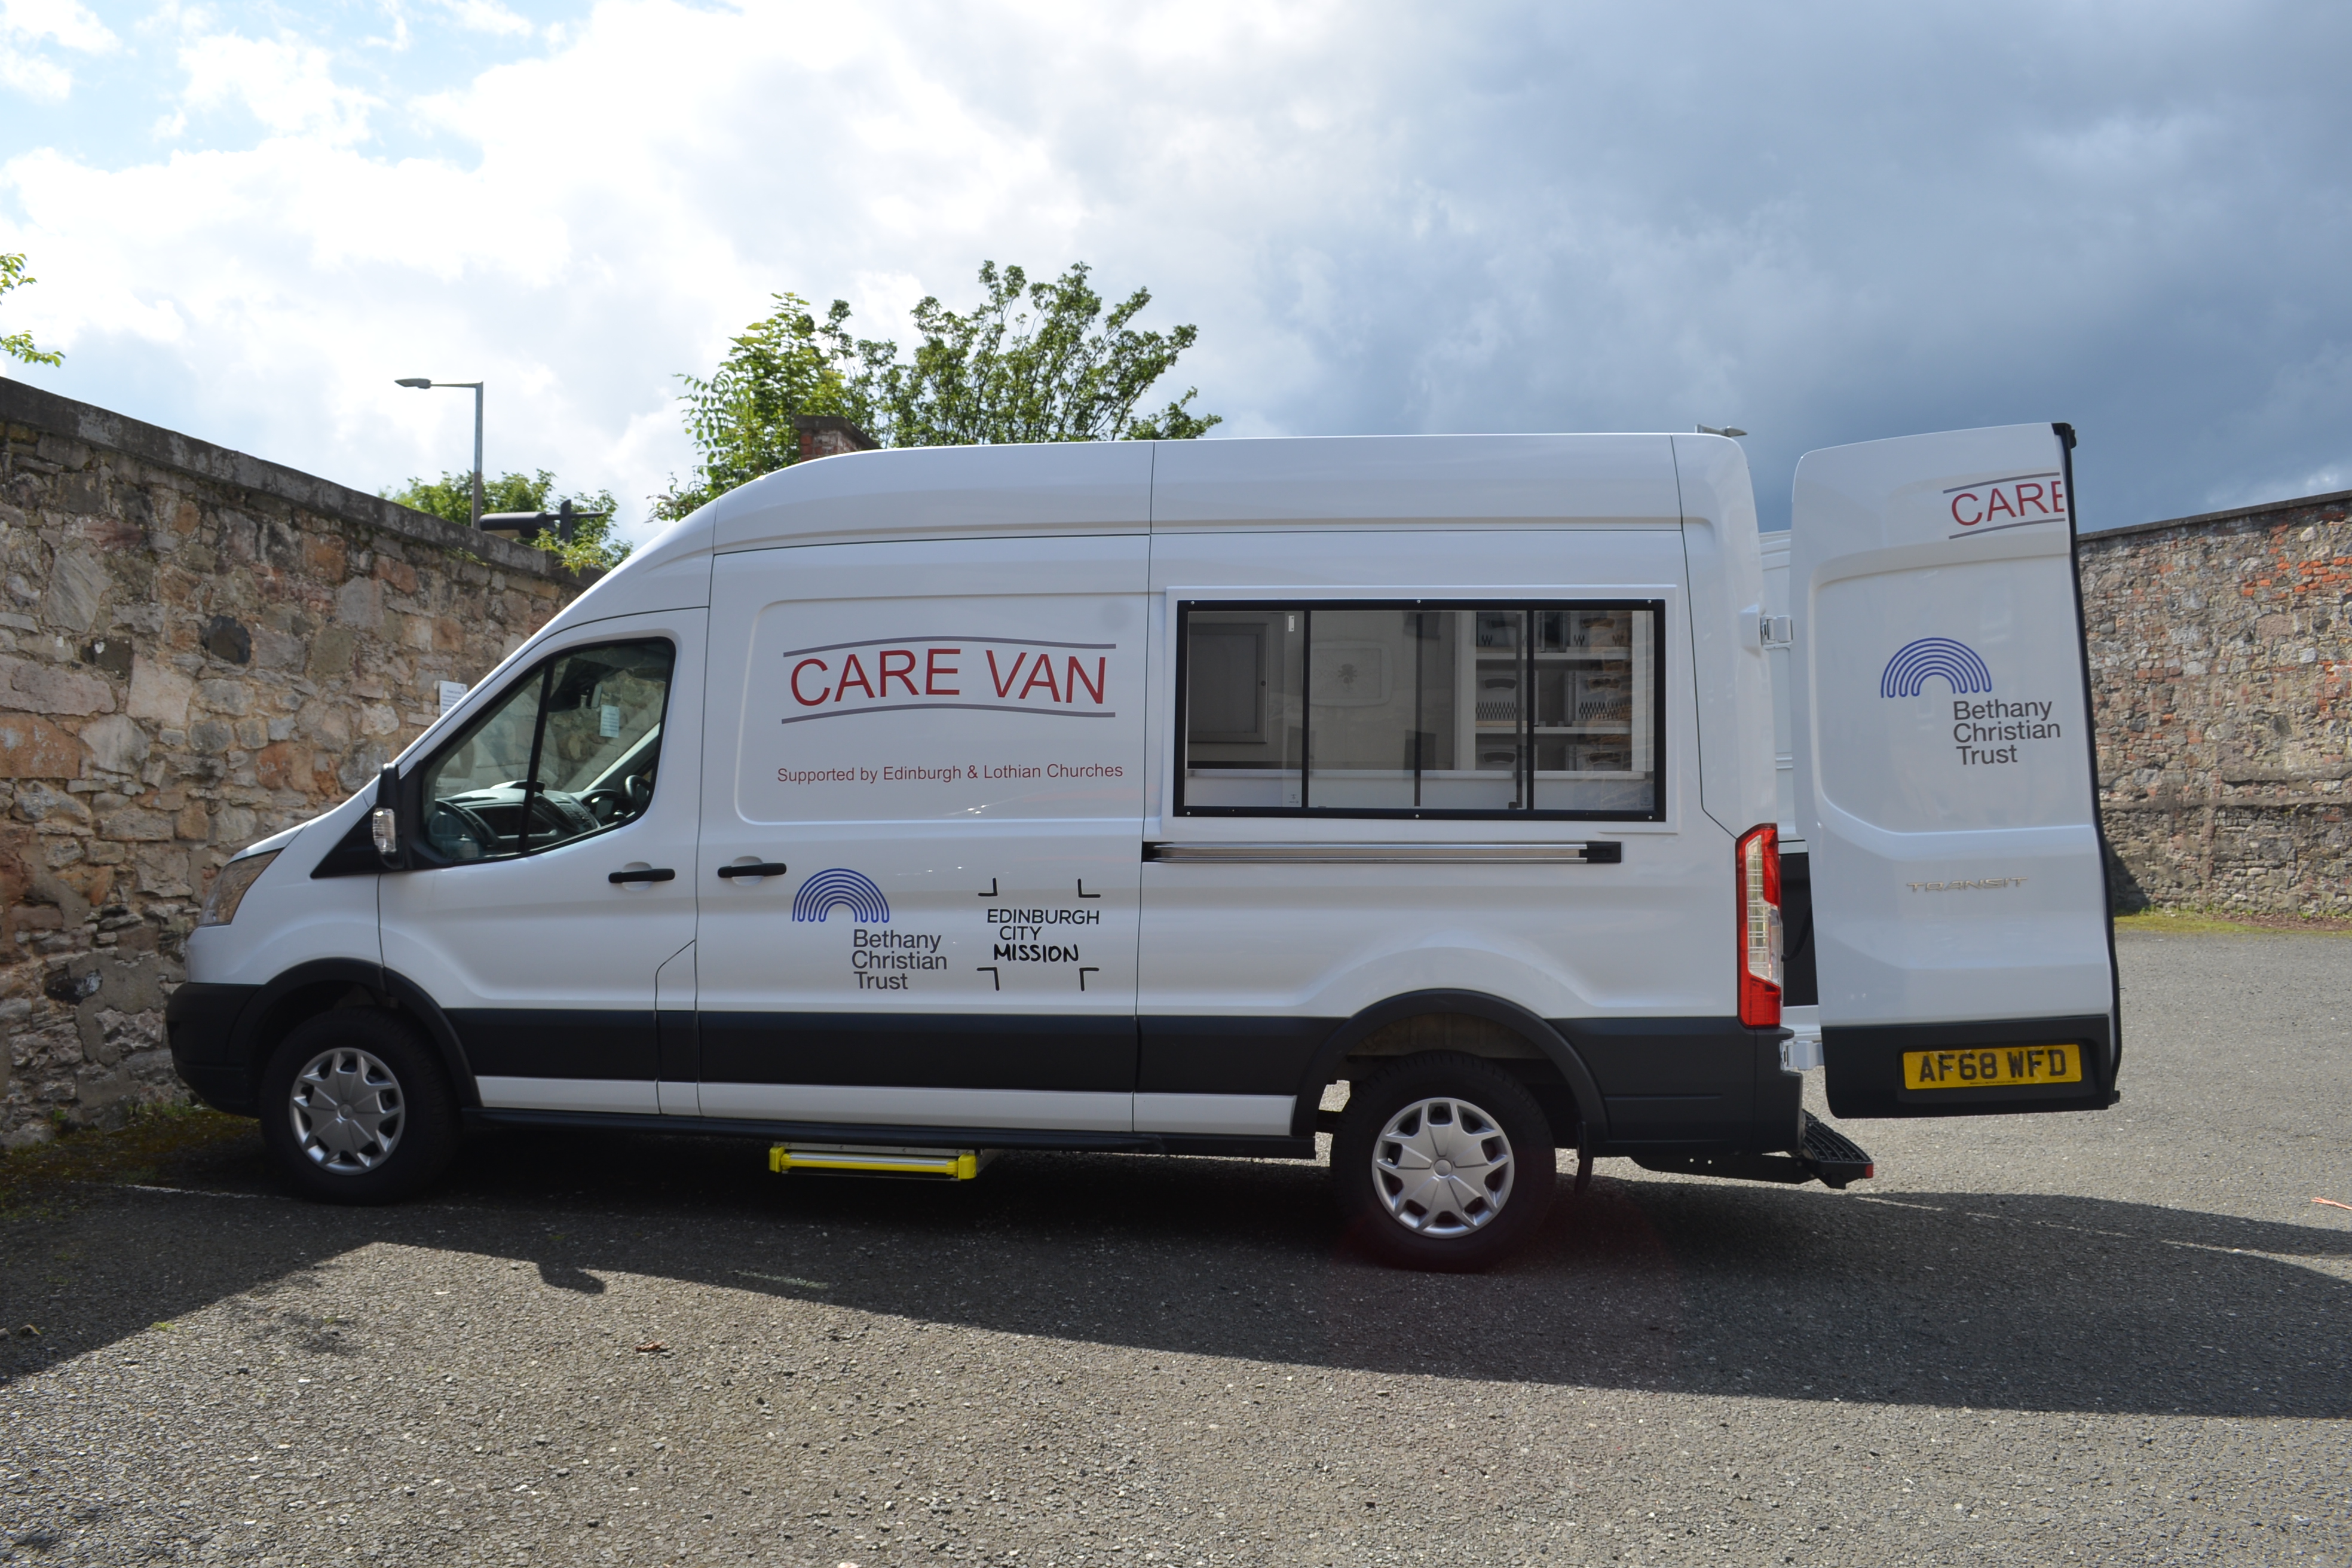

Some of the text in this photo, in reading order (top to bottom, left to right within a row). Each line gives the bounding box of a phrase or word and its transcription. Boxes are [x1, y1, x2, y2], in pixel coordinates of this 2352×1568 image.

[1952, 480, 2065, 525] CARE
[791, 648, 1106, 706] CARE VAN
[1953, 698, 2052, 722] Bethany
[1953, 720, 2061, 743] Christian
[1956, 744, 2018, 765] Trust
[777, 762, 1123, 785] Supported by Edinburgh & Lothian Churches
[1906, 876, 2028, 893] TRANSIT
[987, 908, 1100, 926] EDINBURGH
[853, 929, 942, 951] Bethany
[999, 926, 1043, 941] CITY
[852, 949, 947, 970] Christian
[993, 944, 1079, 963] MISSION
[853, 971, 909, 990] Trust
[1919, 1049, 2067, 1083] AF68 WFD
